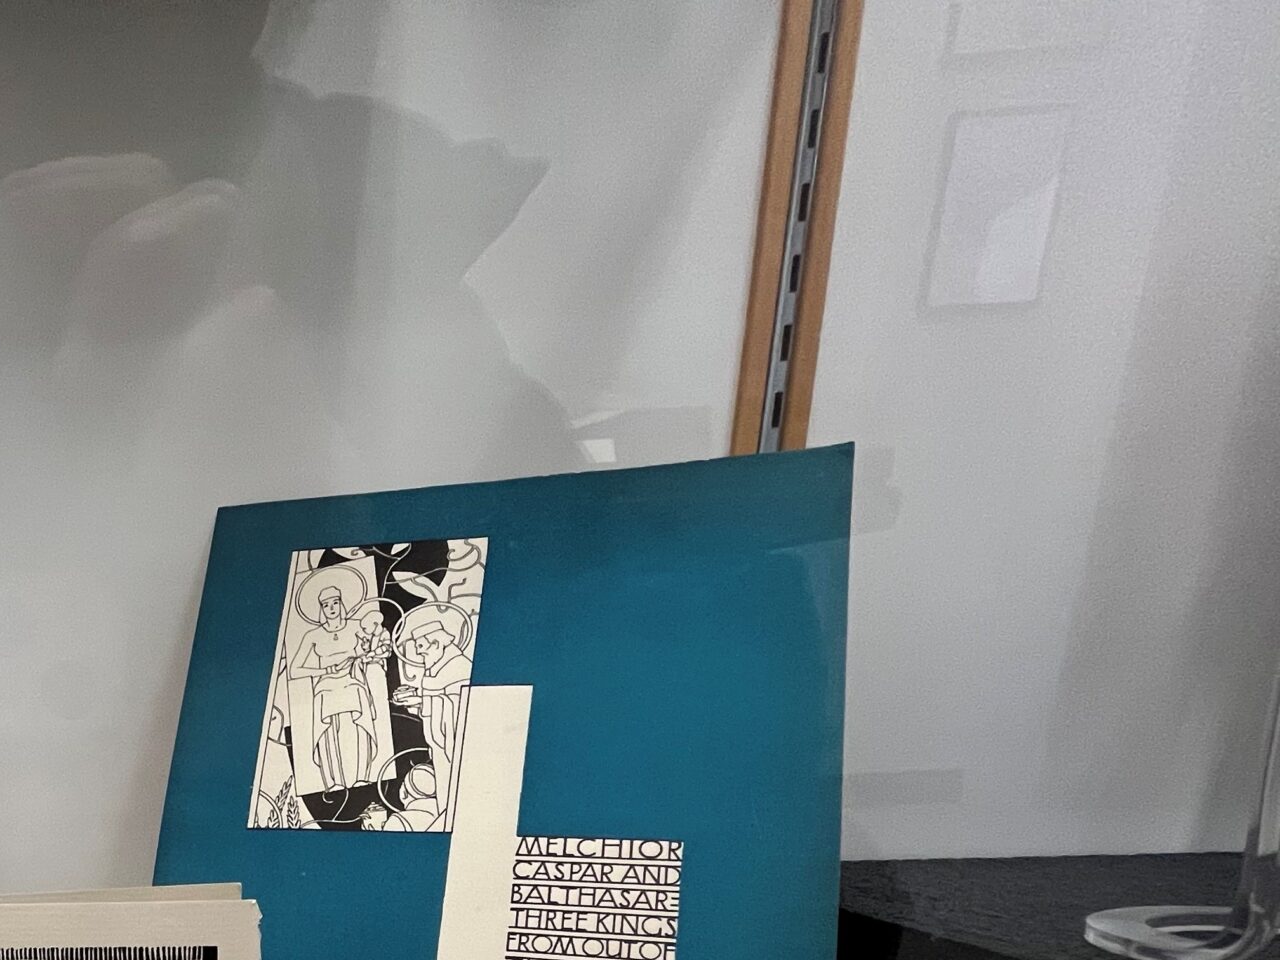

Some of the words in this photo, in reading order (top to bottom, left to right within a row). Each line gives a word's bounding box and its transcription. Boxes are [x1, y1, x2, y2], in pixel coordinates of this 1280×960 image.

[515, 837, 683, 861] MELCHIOR
[512, 861, 615, 884] CASPAR
[620, 865, 682, 886] AND
[509, 908, 588, 932] THREE
[596, 914, 677, 938] KINGS
[506, 932, 576, 955] FROM
